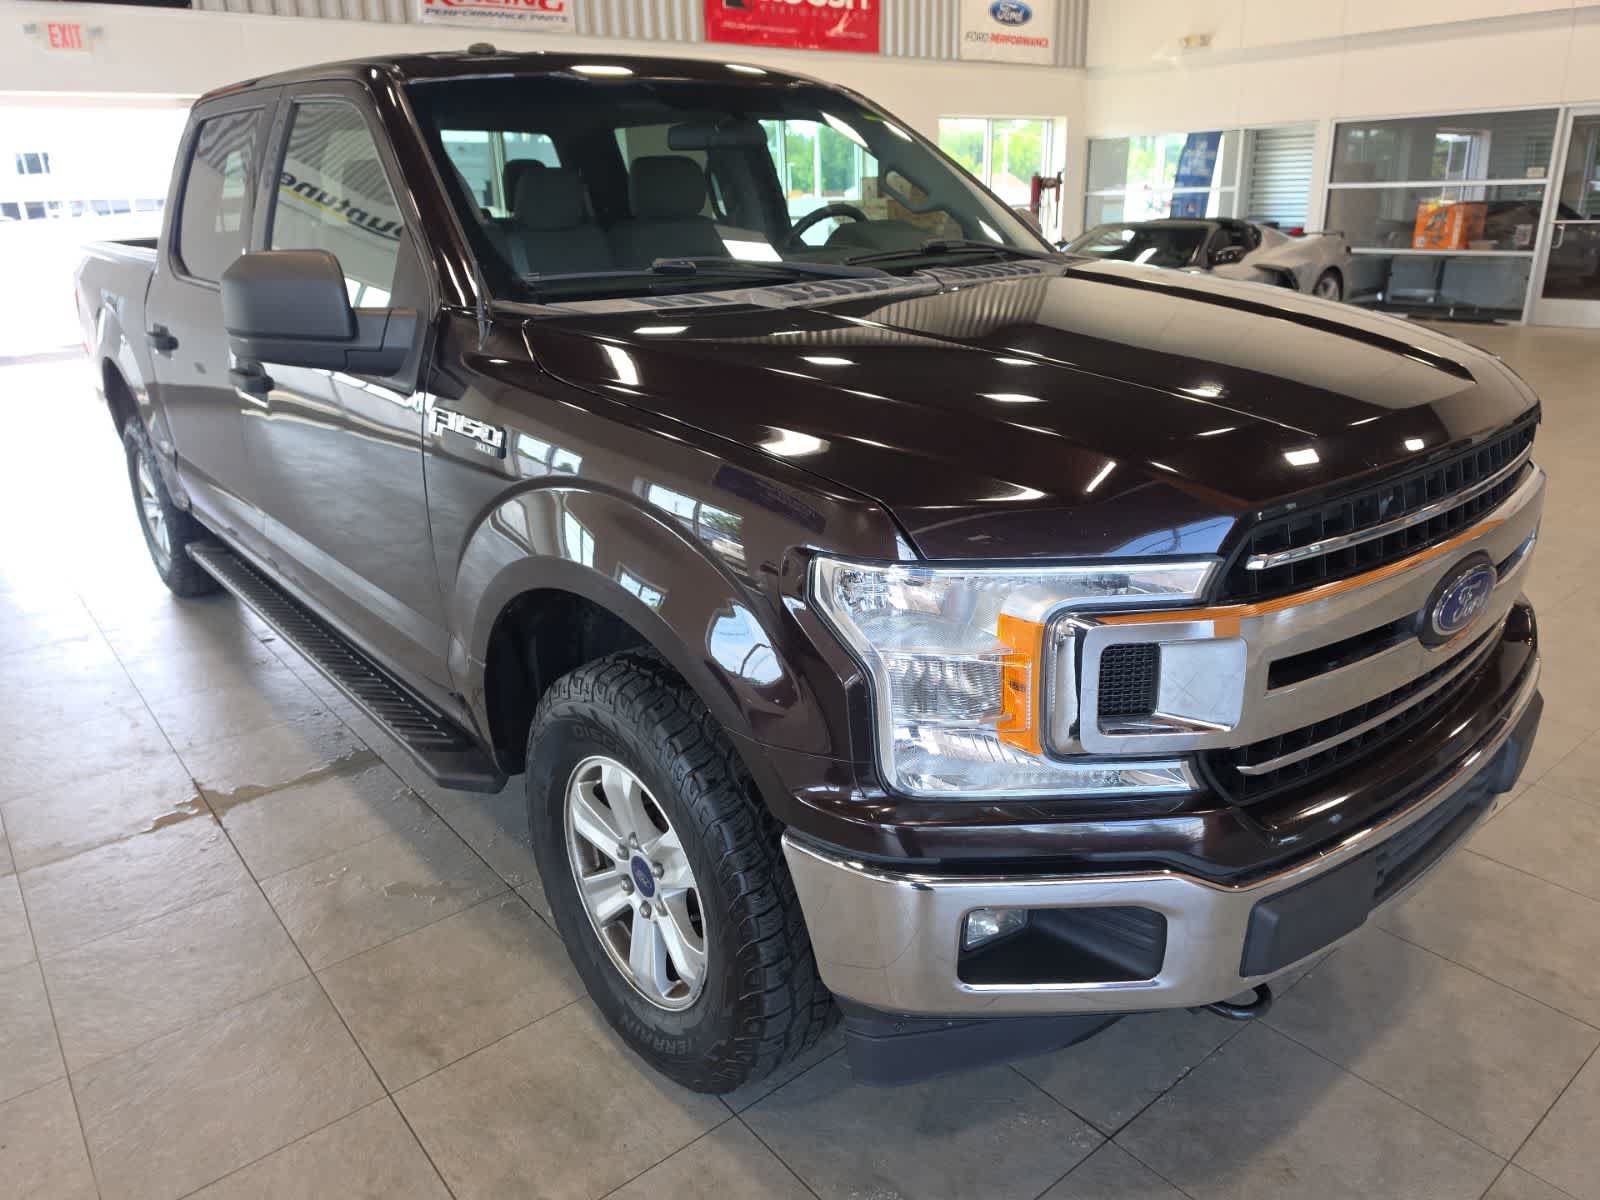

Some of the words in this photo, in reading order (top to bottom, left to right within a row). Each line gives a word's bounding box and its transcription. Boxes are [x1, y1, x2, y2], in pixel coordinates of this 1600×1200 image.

[425, 8, 526, 20] PERFORMANCE
[529, 14, 568, 22] PARTS
[996, 1, 1026, 23] Ford
[48, 23, 82, 48] EXIT
[990, 33, 1049, 49] PERFORMANCE
[1451, 578, 1489, 624] Ford
